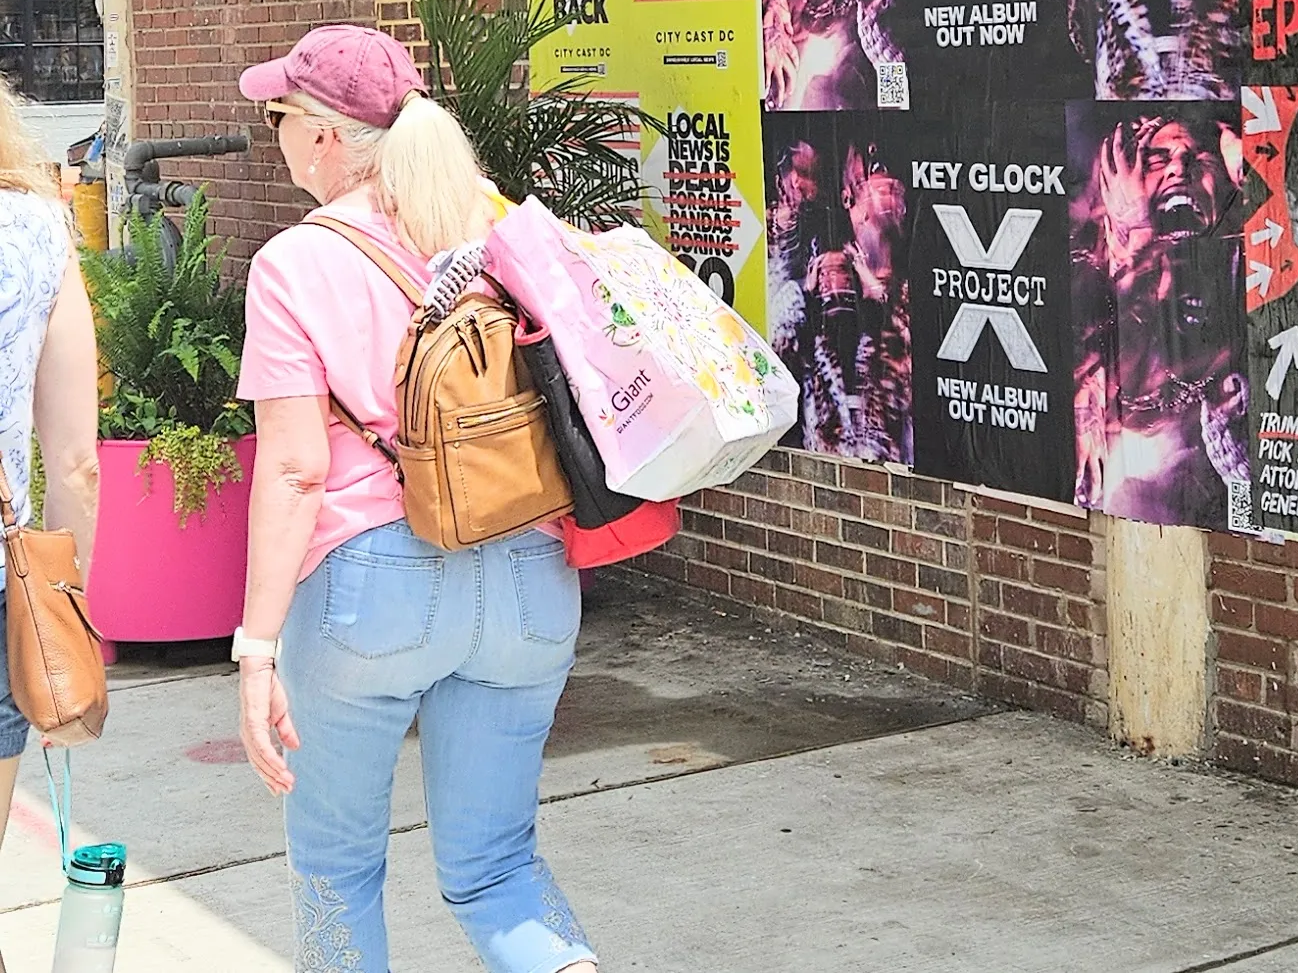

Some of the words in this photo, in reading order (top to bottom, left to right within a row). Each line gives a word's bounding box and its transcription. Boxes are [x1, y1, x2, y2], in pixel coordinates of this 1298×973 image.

[924, 5, 967, 27] NEW
[969, 1, 1037, 25] ALBUM
[656, 31, 681, 43] CITY
[686, 30, 714, 42] CAST
[719, 30, 735, 42] DC
[936, 26, 974, 48] OUT
[980, 23, 1025, 45] NOW
[554, 49, 573, 58] CITY
[576, 48, 596, 57] CAST
[599, 48, 611, 57] DC
[667, 112, 730, 140] LOCAL
[668, 138, 713, 161] NEWS
[716, 140, 730, 162] IS
[669, 160, 731, 193] DEAD
[911, 161, 963, 190] KEY
[969, 163, 1065, 195] GLOCK
[670, 191, 696, 211] FOR
[698, 194, 731, 213] SALE
[670, 210, 732, 234] PANDAS
[671, 231, 733, 257] BORING
[933, 268, 1046, 306] PROJECT
[611, 368, 652, 412] Giant
[937, 376, 977, 401] NEW
[981, 386, 1048, 412] ALBUM
[948, 402, 985, 424] OUT
[990, 409, 1037, 432] NOW
[1258, 439, 1294, 463] PICK
